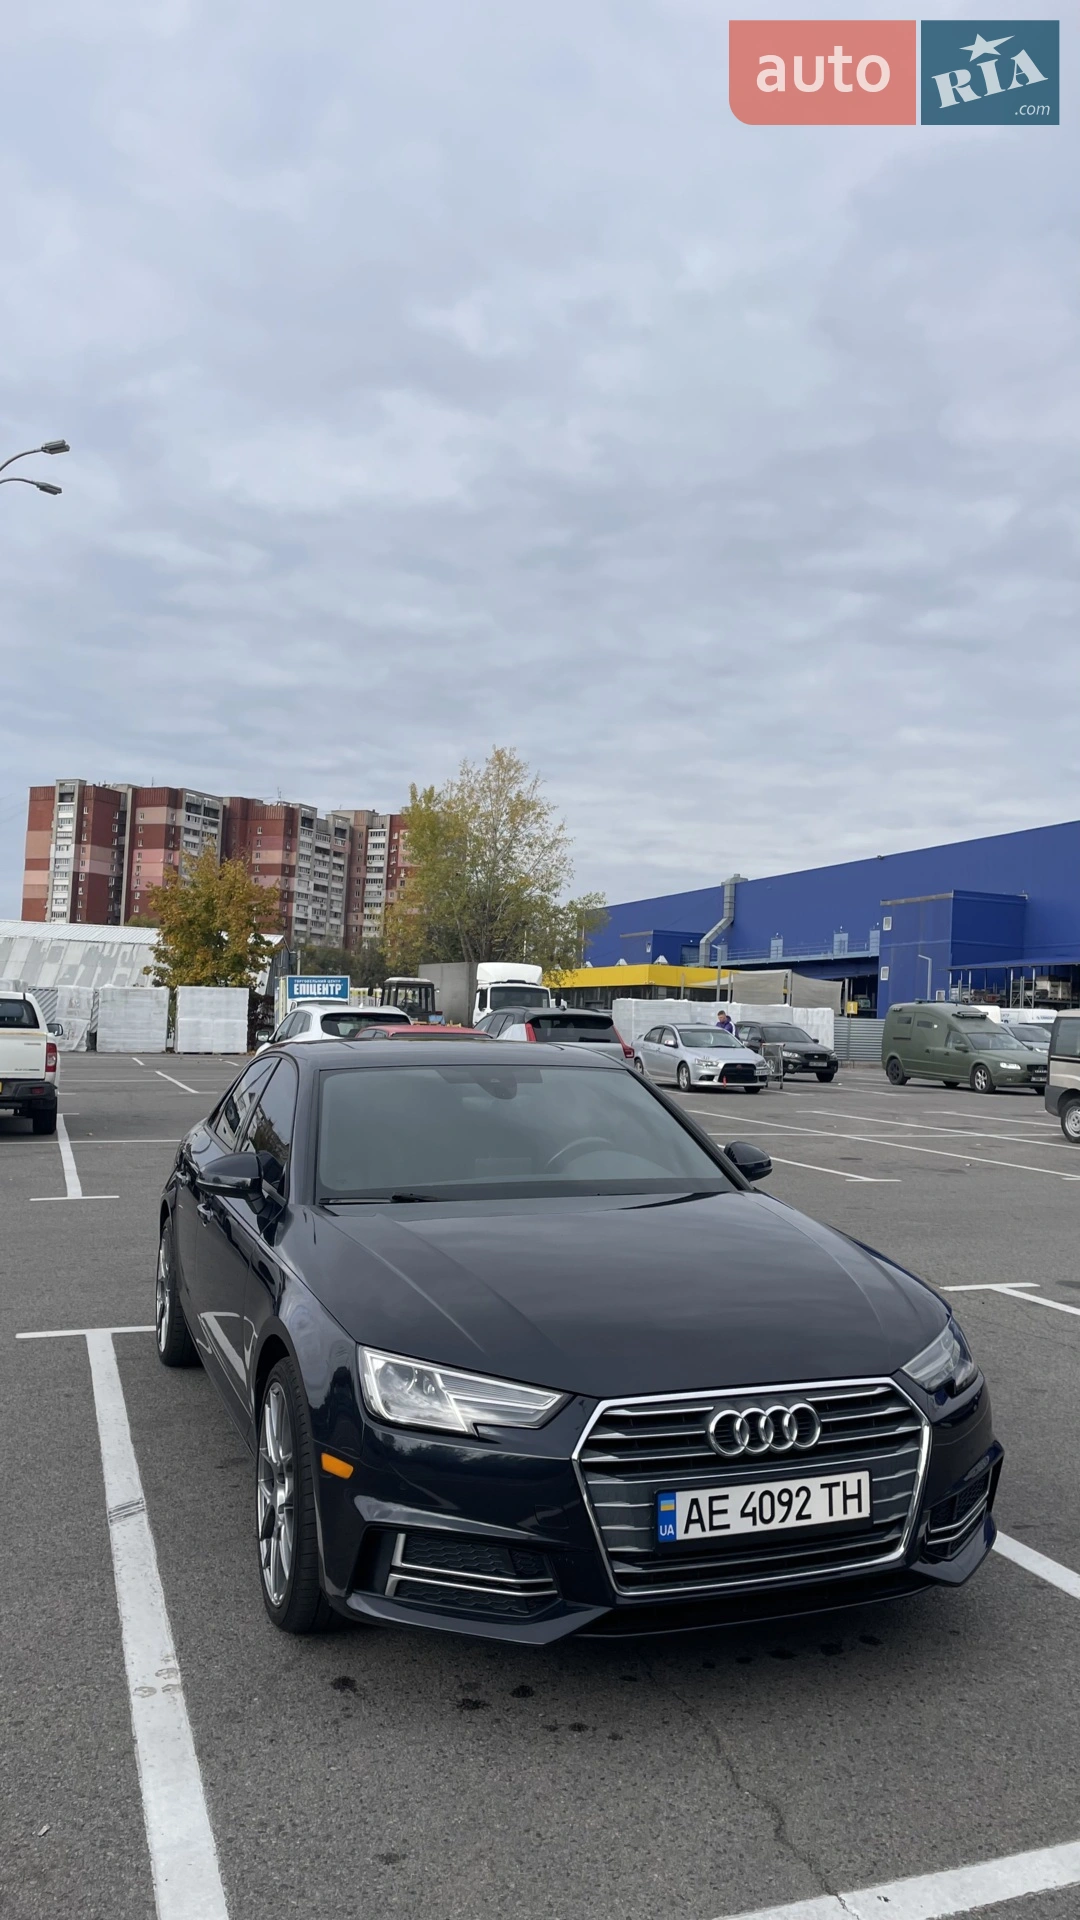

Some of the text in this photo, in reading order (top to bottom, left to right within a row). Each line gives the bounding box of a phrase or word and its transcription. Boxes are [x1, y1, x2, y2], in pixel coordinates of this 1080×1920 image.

[293, 983, 342, 996] ЕПІЦЕНТР
[683, 1478, 863, 1535] AE 4092 TH
[659, 1524, 675, 1537] UA
